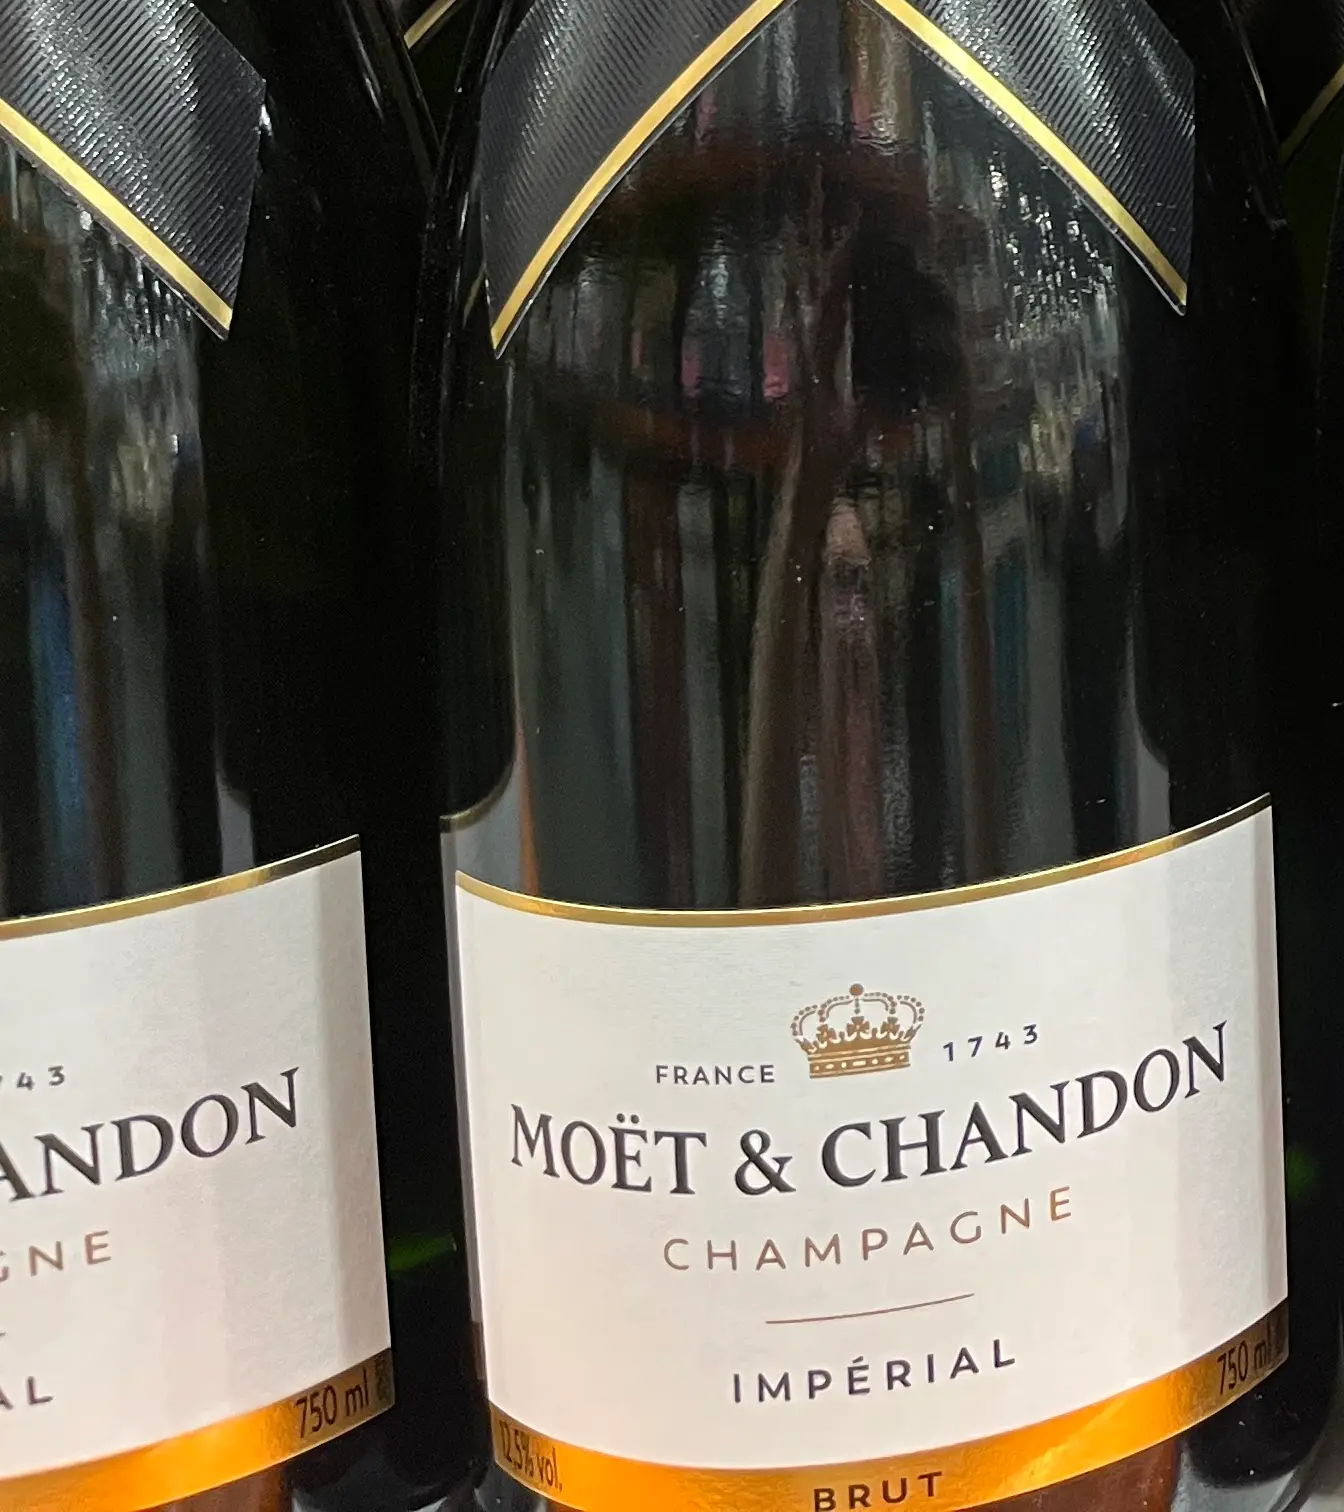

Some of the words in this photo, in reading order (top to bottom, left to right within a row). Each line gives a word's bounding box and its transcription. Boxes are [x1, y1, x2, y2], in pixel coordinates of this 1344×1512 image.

[0, 1065, 66, 1092] 43
[655, 1063, 776, 1086] FRANCE
[942, 1023, 1040, 1062] 1743
[510, 1102, 708, 1196] MOËT
[733, 1128, 798, 1197] &
[820, 1020, 1229, 1189] CHANDON
[663, 1185, 1072, 1271] CHAMPAGNE
[733, 1338, 1016, 1404] IMPÉRIAL
[1217, 1339, 1249, 1396] 750
[293, 1385, 338, 1439] 750
[345, 1369, 370, 1418] ml
[536, 1447, 563, 1492] vol.
[813, 1471, 943, 1512] BRUT
